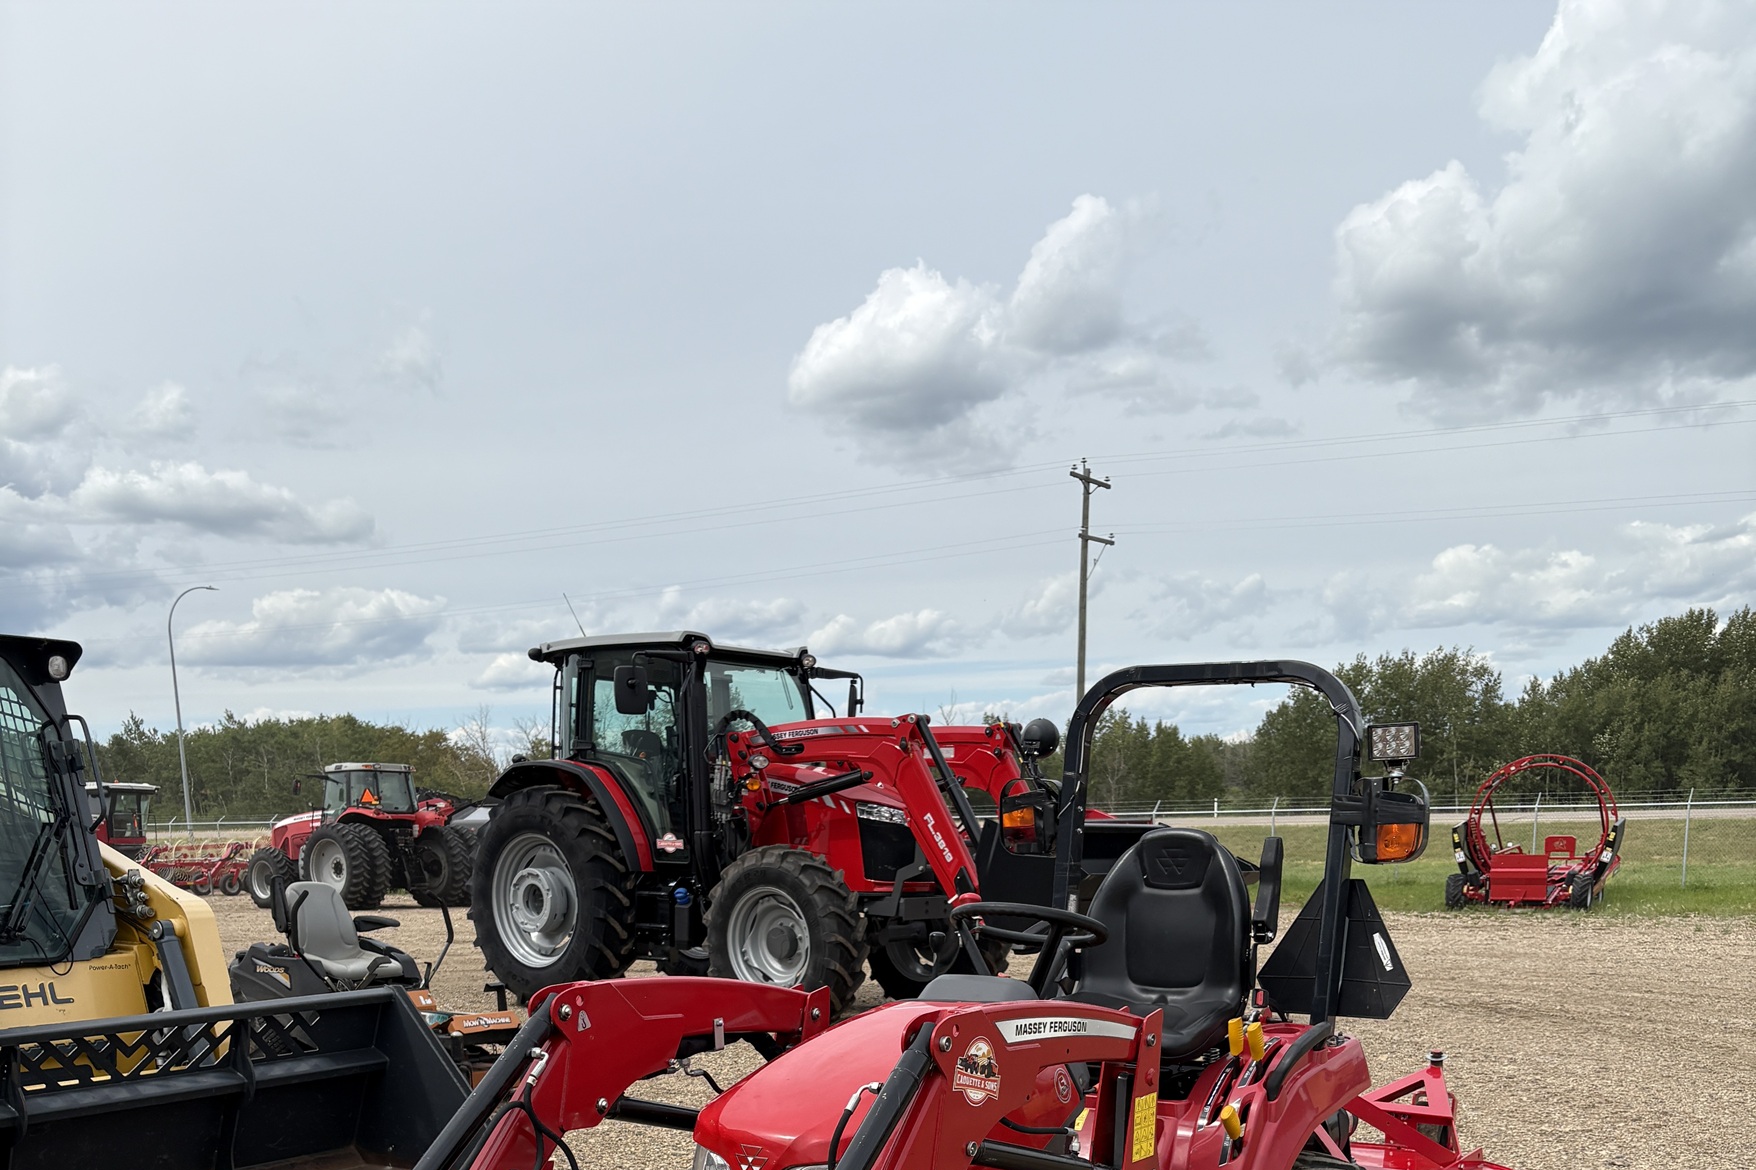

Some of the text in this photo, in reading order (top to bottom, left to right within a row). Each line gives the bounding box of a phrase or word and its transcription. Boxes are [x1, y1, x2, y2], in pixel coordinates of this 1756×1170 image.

[773, 728, 819, 740] SSEY FERGUSON
[1015, 1020, 1088, 1036] MASSEY FERGUSON
[984, 1080, 998, 1092] SONS
